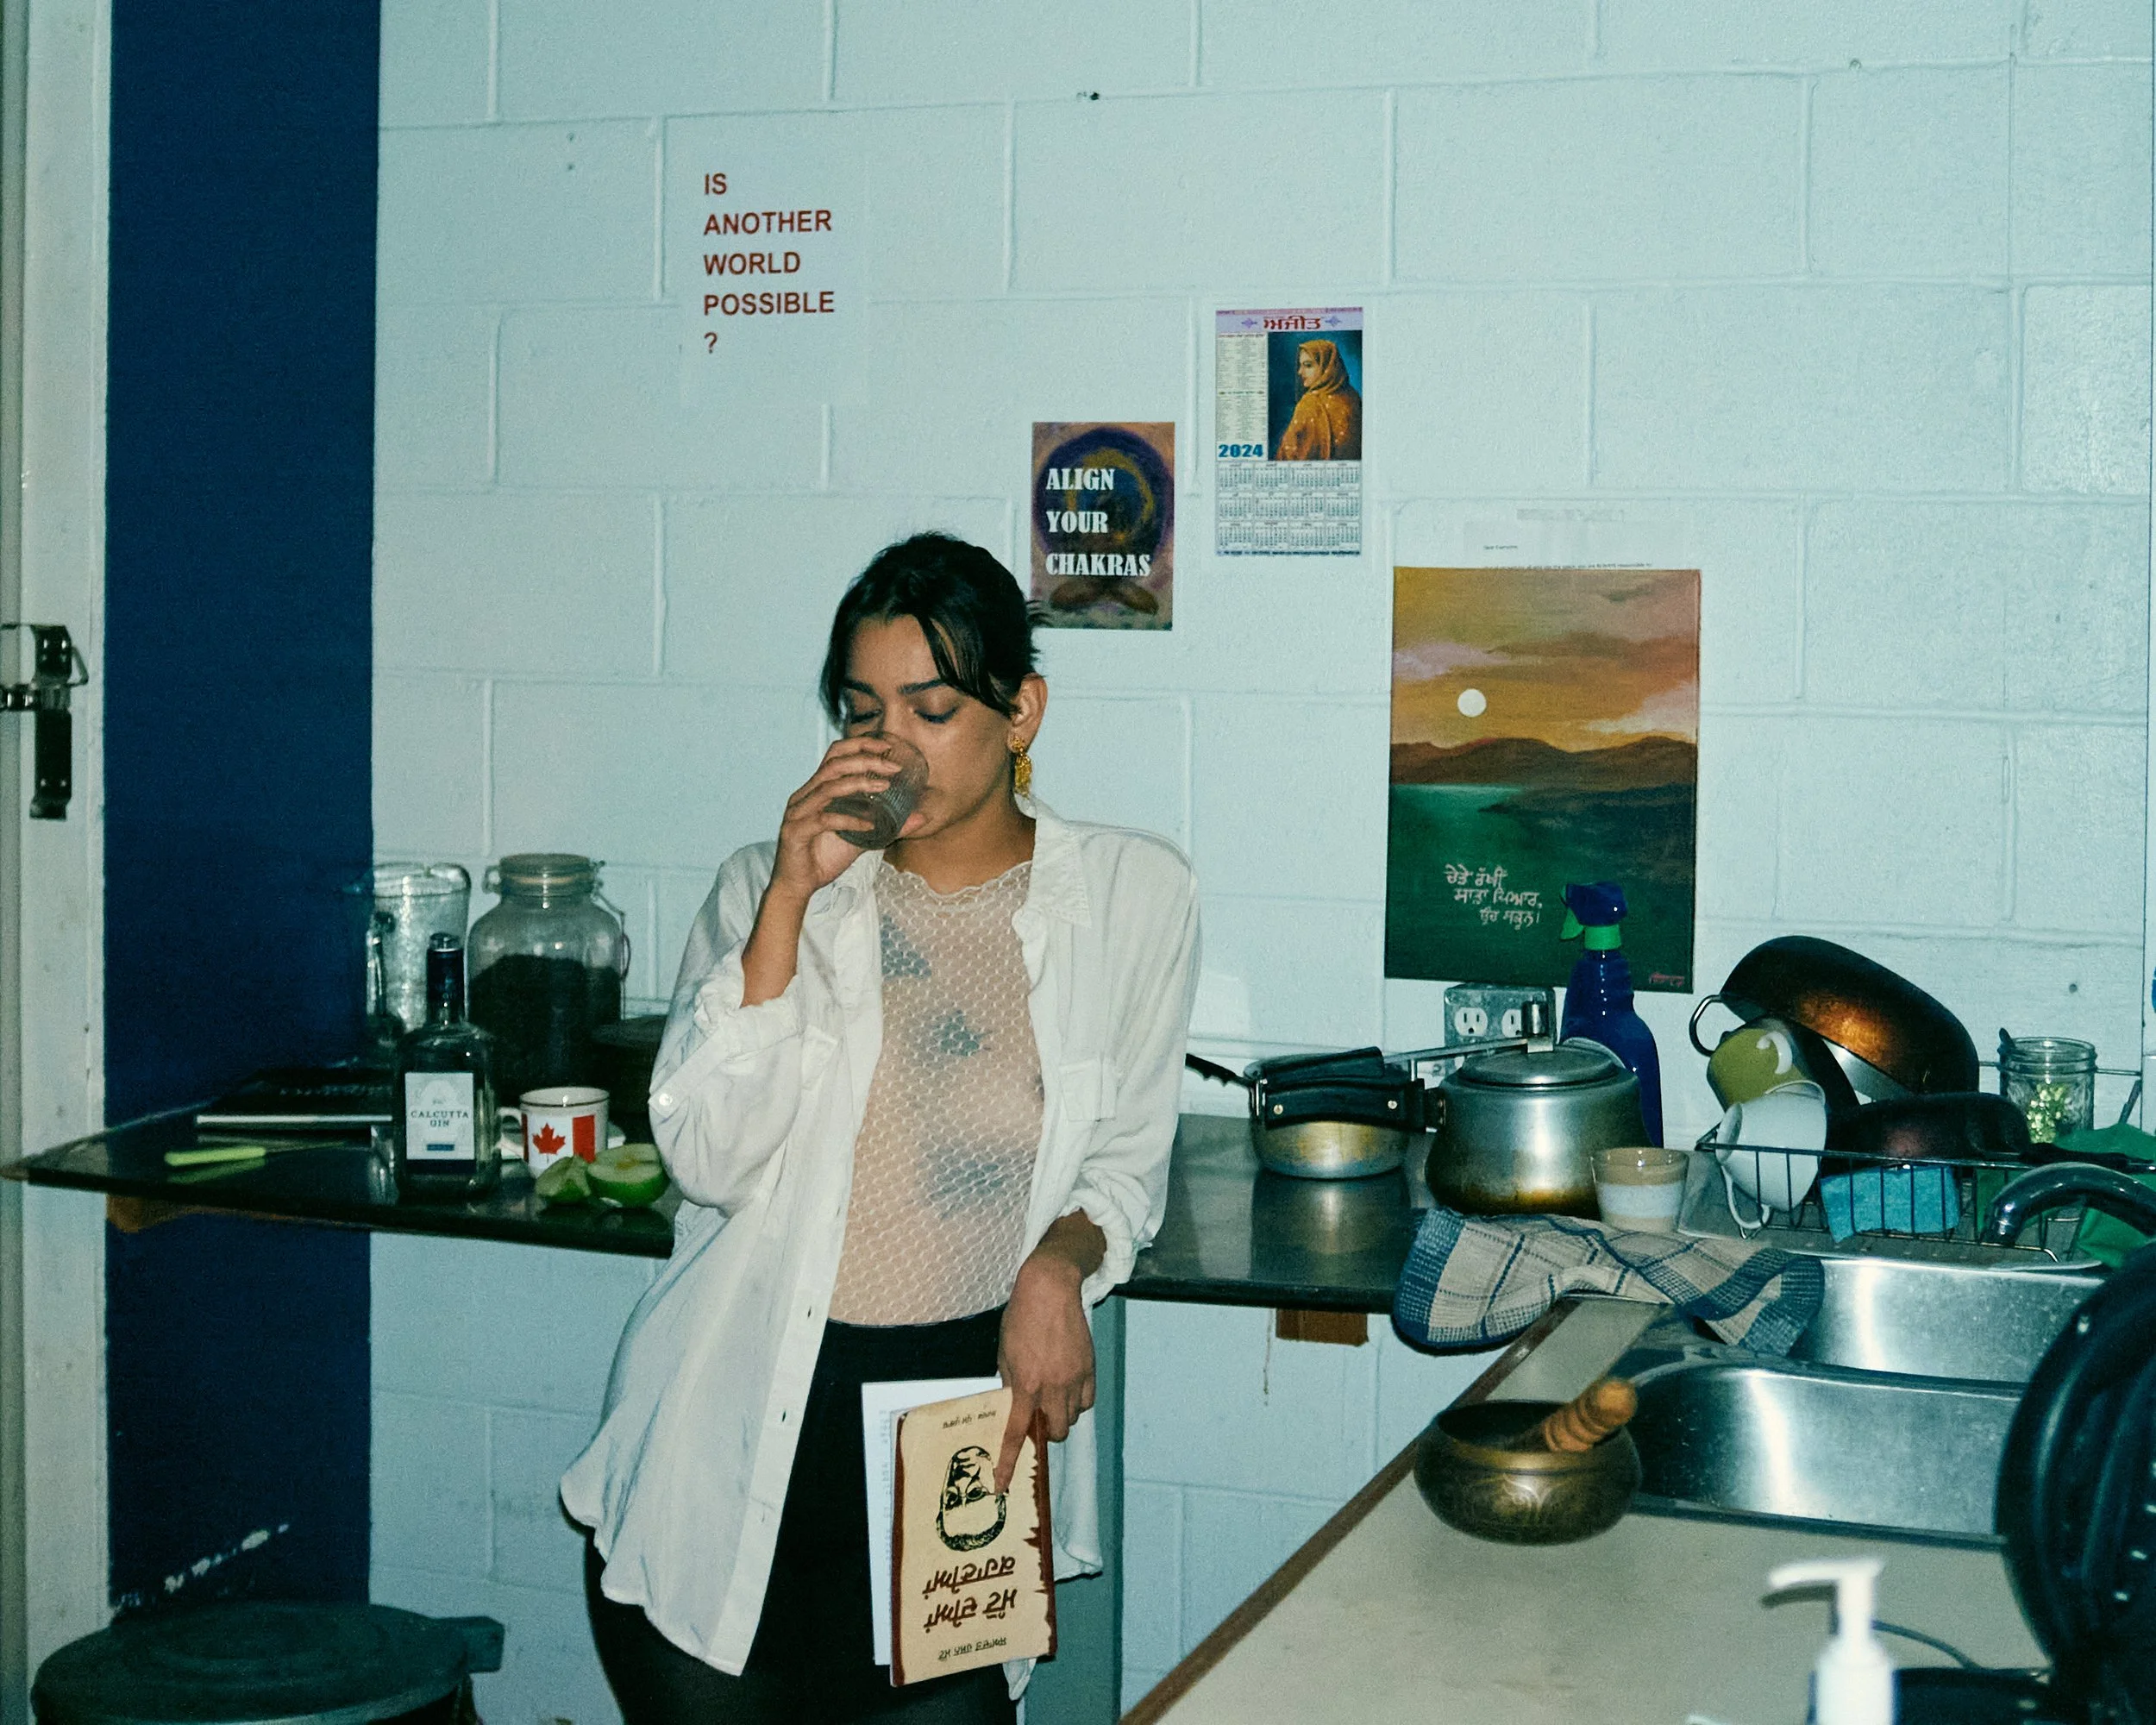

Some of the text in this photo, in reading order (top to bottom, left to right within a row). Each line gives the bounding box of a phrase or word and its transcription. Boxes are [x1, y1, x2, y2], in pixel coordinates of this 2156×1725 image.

[705, 172, 728, 196] IS
[703, 210, 832, 236] ANOTHER
[703, 251, 801, 276] WORLD
[704, 291, 835, 317] POSSIBLE
[1263, 315, 1321, 330] ਅਜੀਤ
[703, 331, 718, 354] ?
[1219, 443, 1263, 458] 2024
[1045, 467, 1115, 491] ALIGN
[1045, 510, 1108, 534] YOUR
[1045, 553, 1151, 577] CHAKRAS
[410, 1110, 469, 1120] CALCUTTA
[429, 1119, 450, 1127] GIN
[922, 1555, 1016, 1600] ਕਹਾਣੀਆਂ
[923, 1589, 1018, 1634] ਮੰਟੋ ਦੀਆਂ
